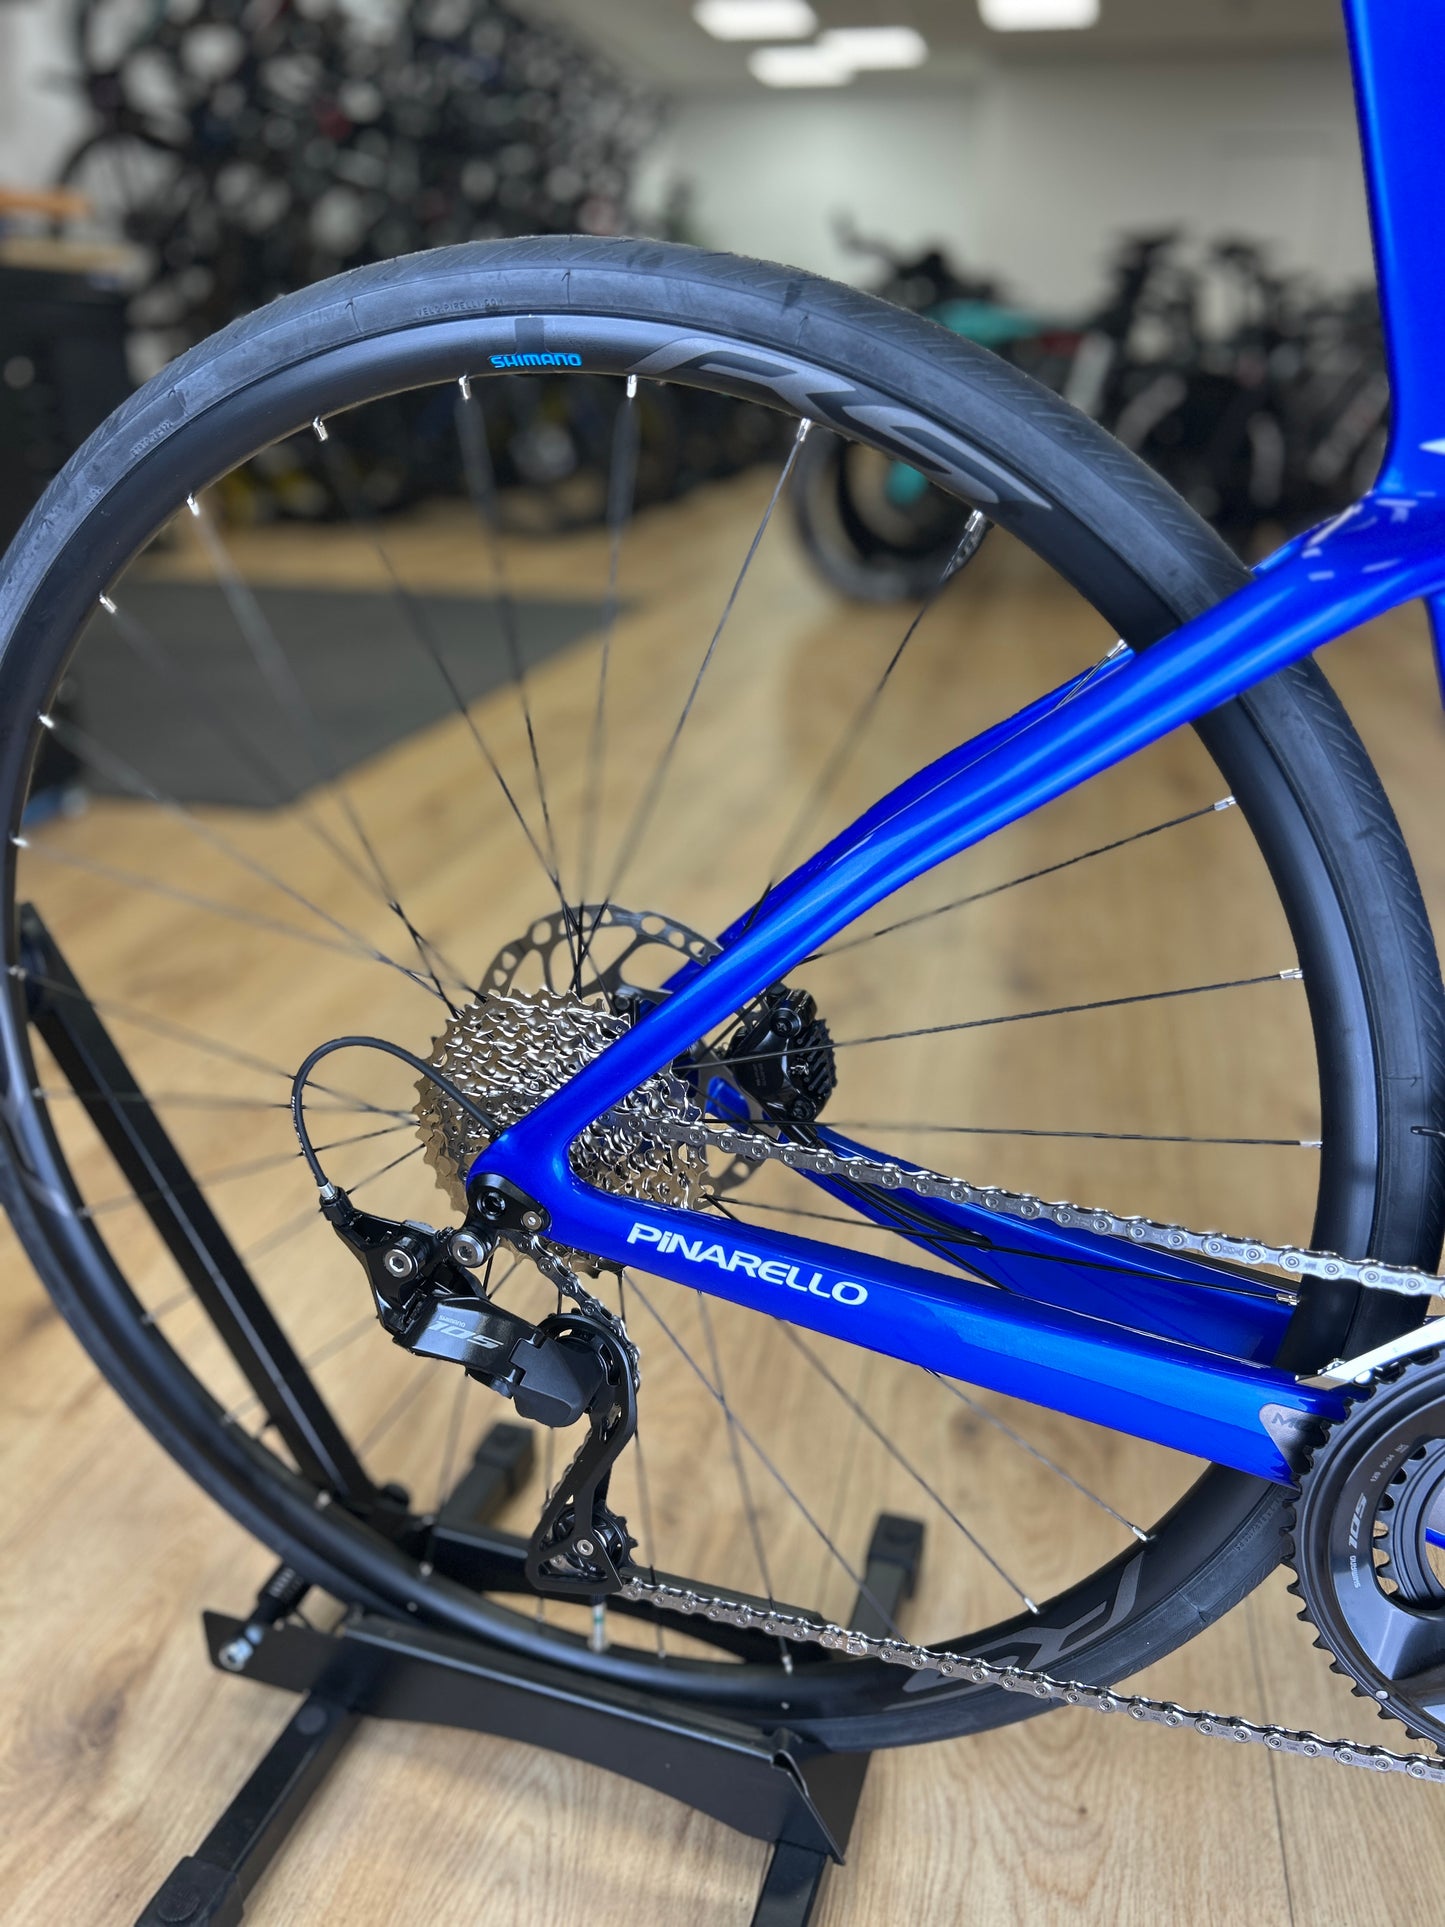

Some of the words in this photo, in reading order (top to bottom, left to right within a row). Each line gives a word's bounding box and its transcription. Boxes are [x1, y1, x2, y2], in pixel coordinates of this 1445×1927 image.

[490, 352, 582, 368] SHIMANO
[626, 1222, 868, 1306] PINARELLO
[428, 1320, 504, 1349] 105
[1349, 1492, 1367, 1549] 105
[1350, 1555, 1361, 1589] SHIMANO
